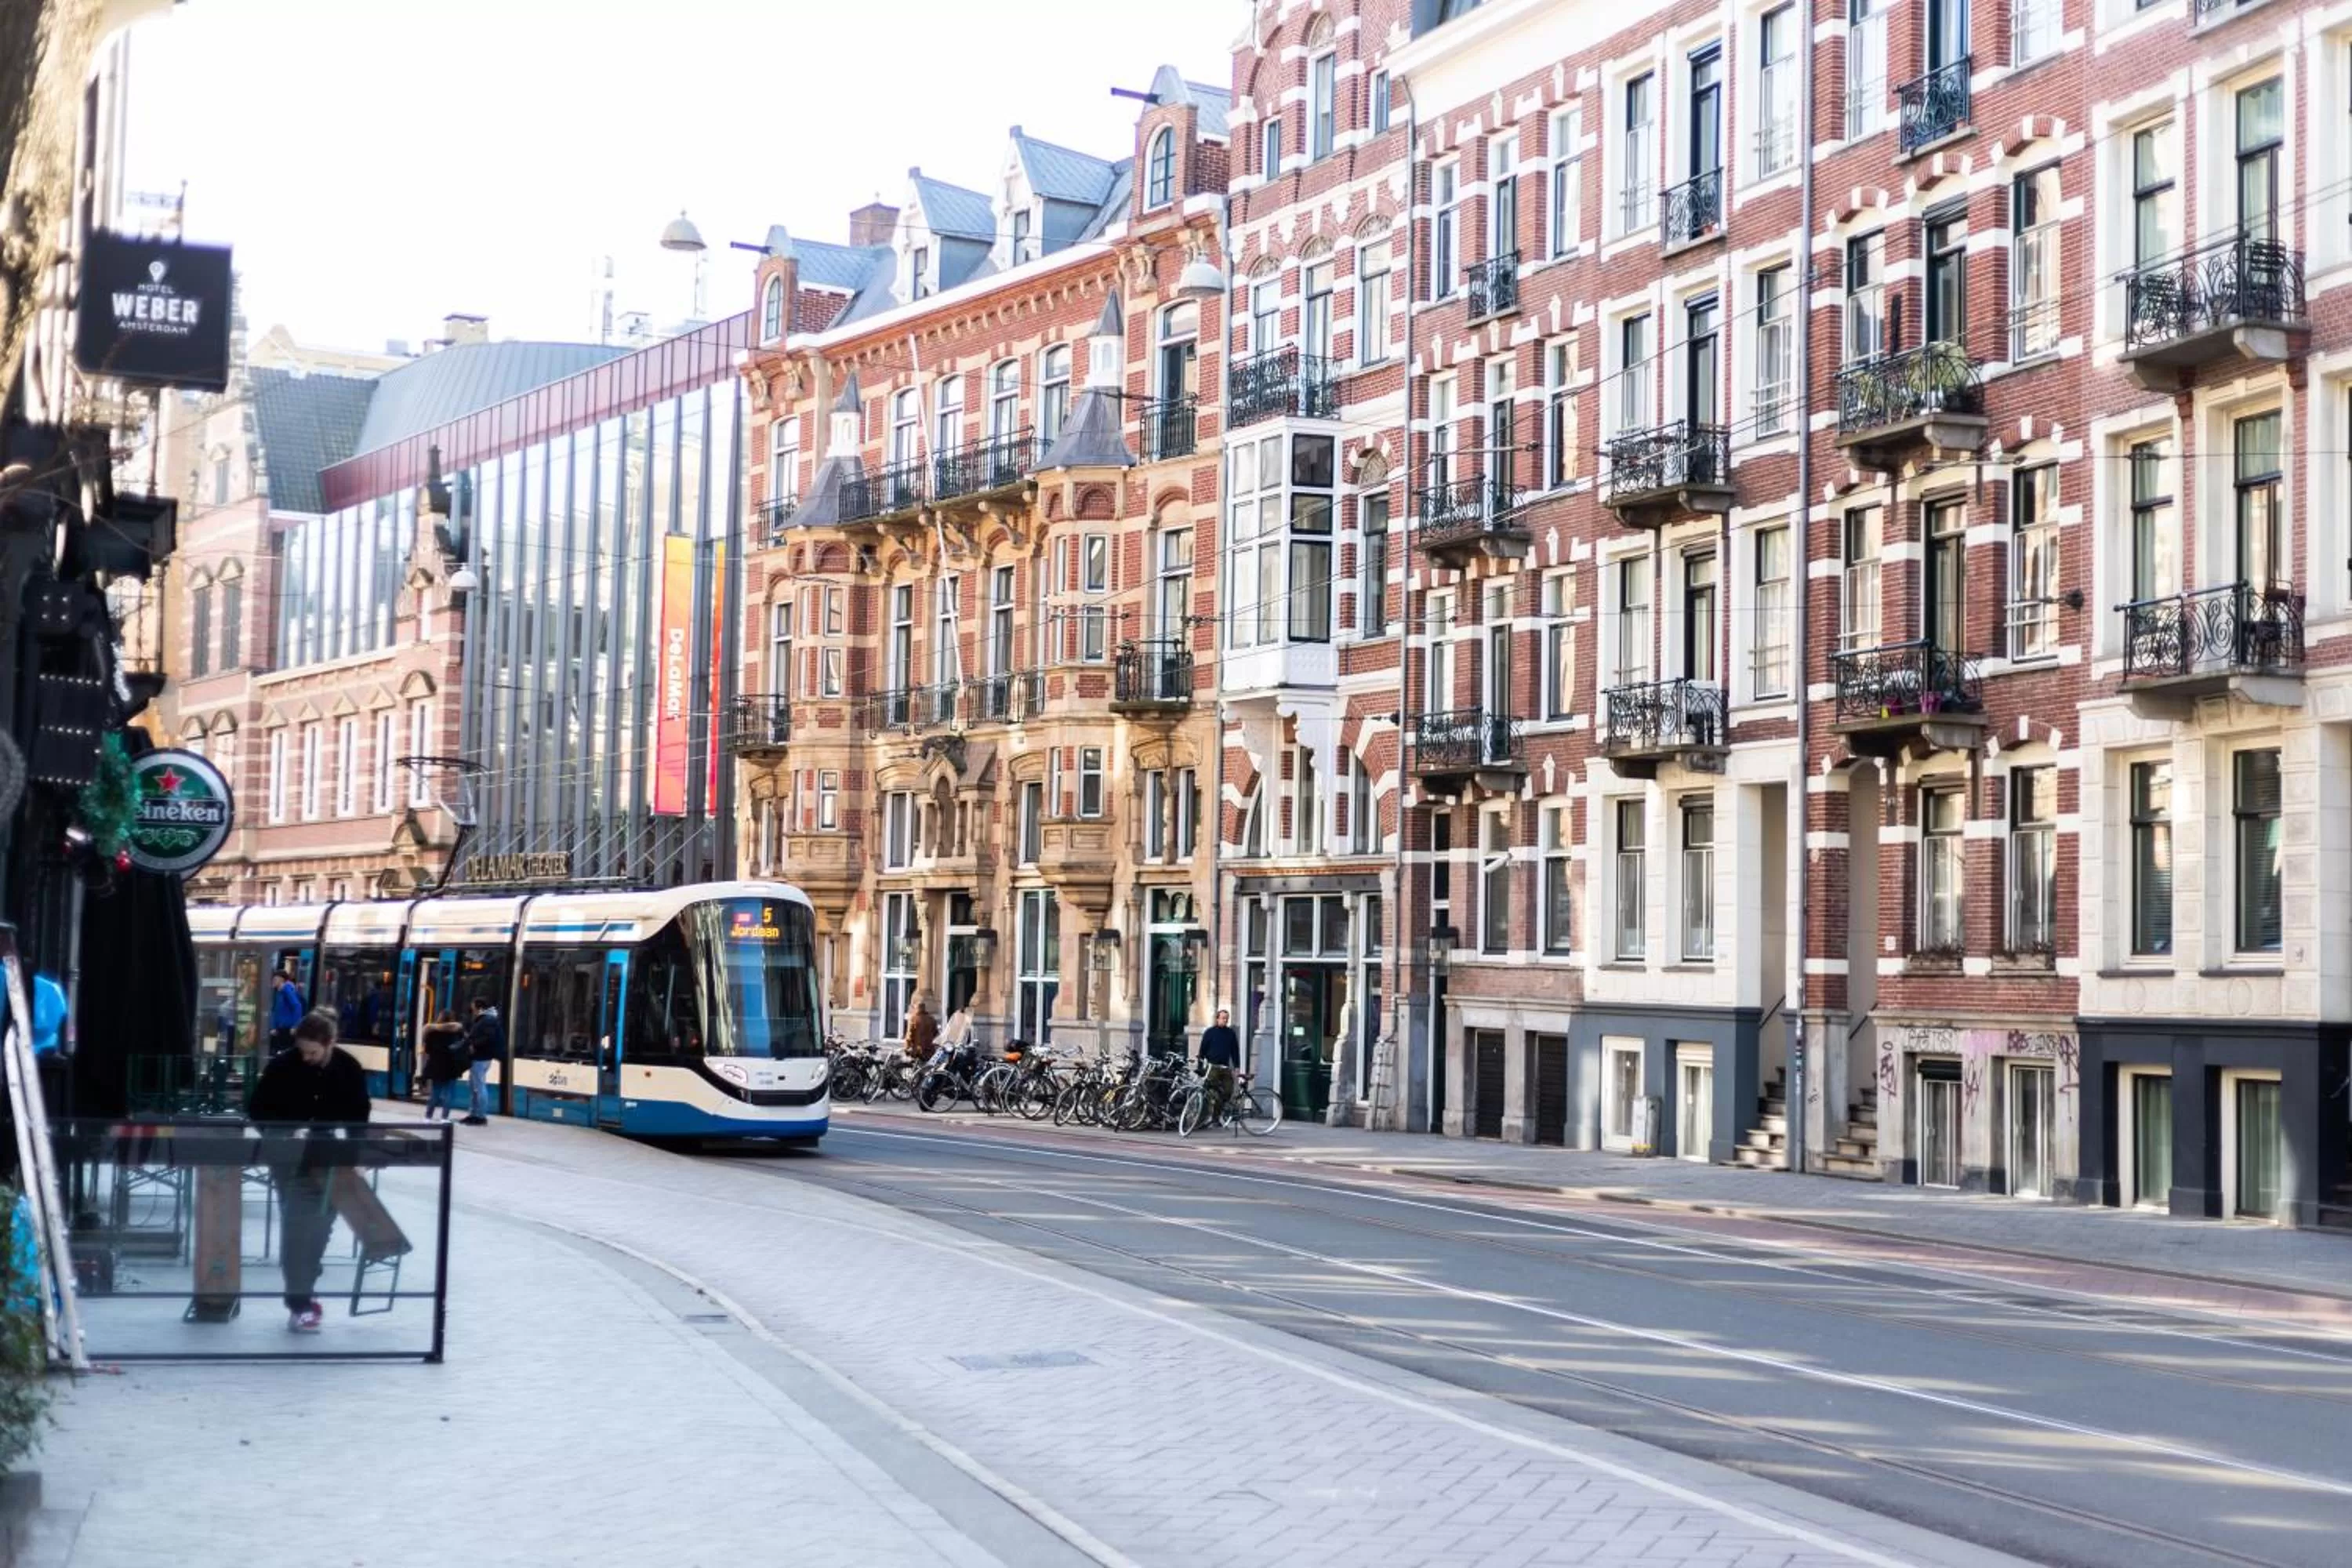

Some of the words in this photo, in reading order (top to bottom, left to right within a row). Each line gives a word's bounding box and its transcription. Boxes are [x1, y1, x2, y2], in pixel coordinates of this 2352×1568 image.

[137, 283, 176, 294] HOTEL
[112, 292, 198, 323] WEBER
[118, 321, 189, 334] AMSTERDAM
[134, 800, 220, 822] eineken
[526, 855, 568, 876] THEATER
[763, 907, 773, 923] 5
